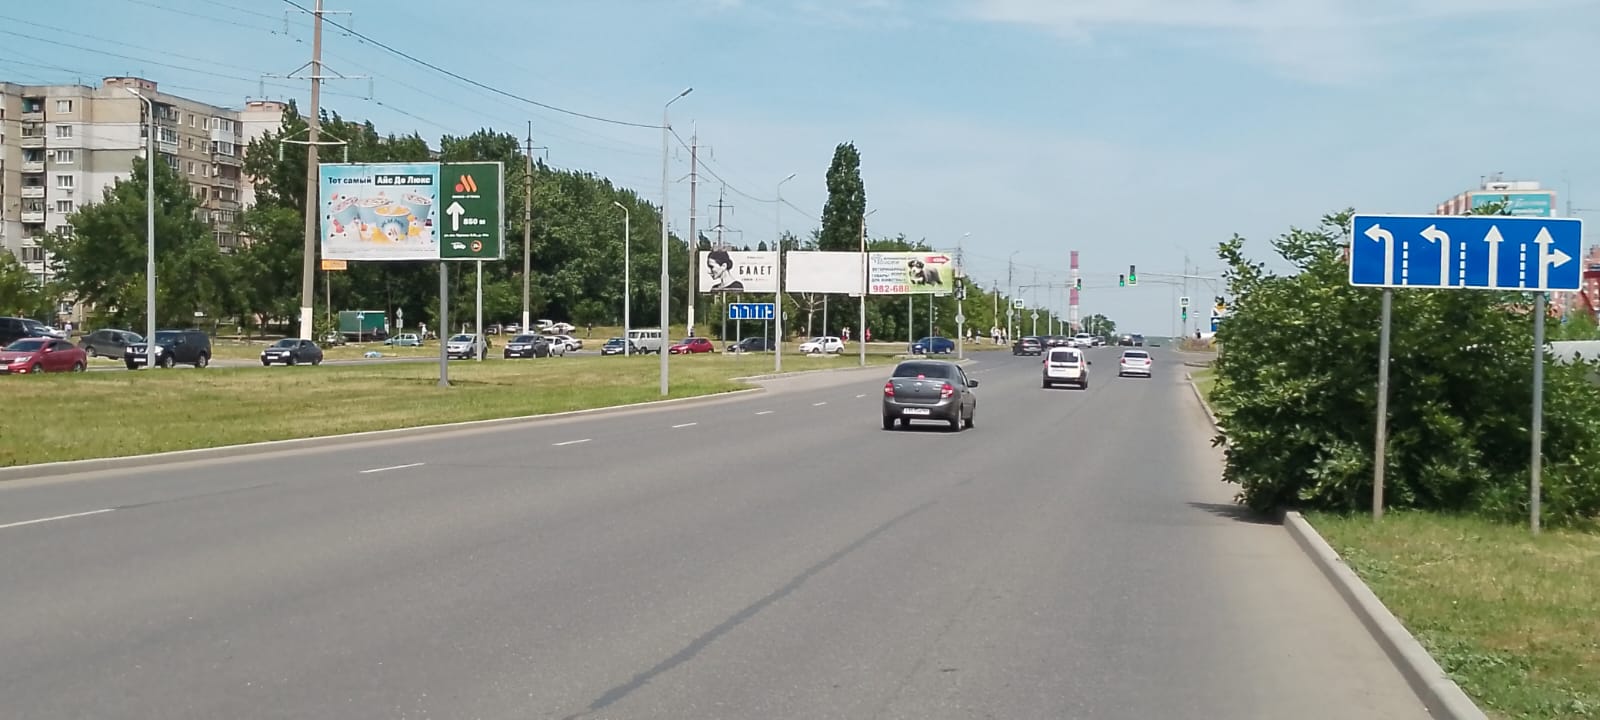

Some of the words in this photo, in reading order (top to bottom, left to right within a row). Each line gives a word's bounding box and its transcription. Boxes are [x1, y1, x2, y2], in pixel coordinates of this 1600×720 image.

[328, 176, 341, 184] Тот
[343, 176, 372, 184] самый
[377, 176, 393, 184] Айс
[407, 176, 431, 184] Люкс
[739, 265, 772, 275] БАЛЕТ
[872, 285, 909, 293] 982-688
